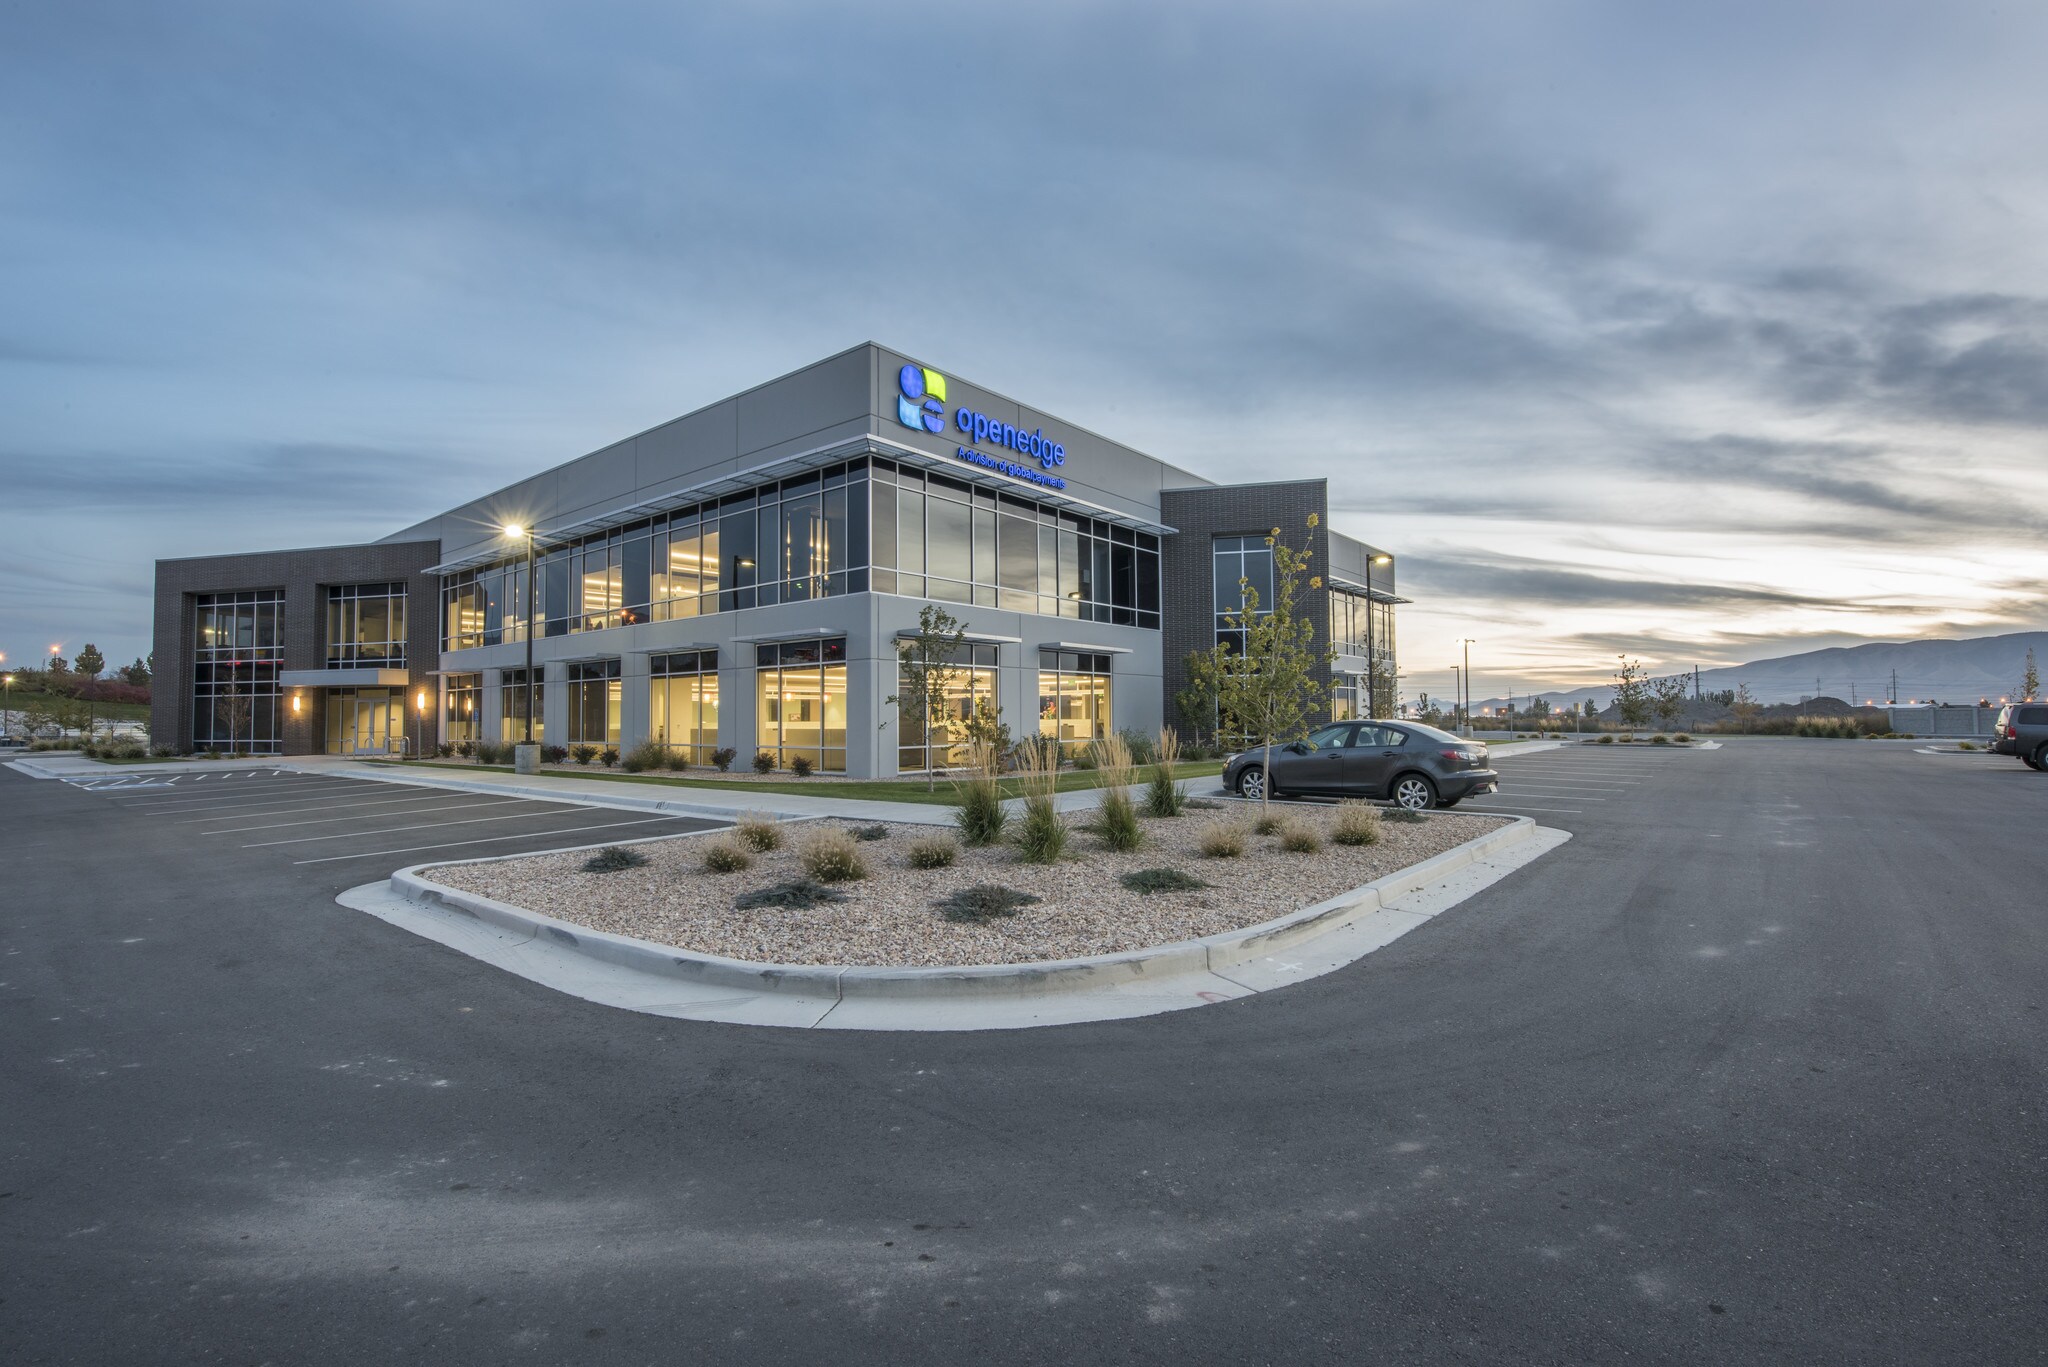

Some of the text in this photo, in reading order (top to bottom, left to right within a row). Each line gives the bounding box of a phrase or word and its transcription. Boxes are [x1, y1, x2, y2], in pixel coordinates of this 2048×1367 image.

[956, 406, 1065, 469] openedge
[956, 446, 1066, 490] A division of globalpayments
